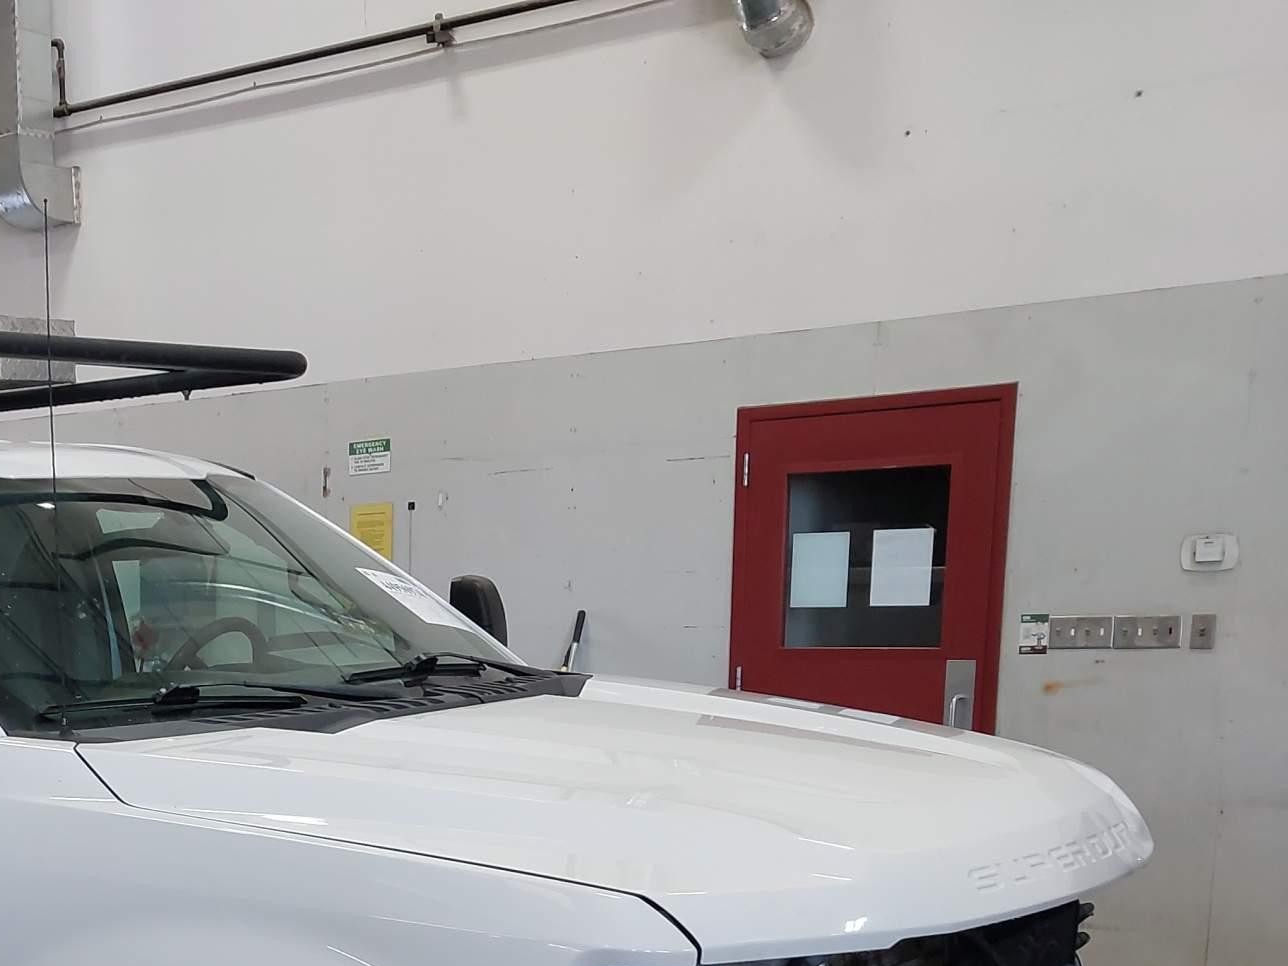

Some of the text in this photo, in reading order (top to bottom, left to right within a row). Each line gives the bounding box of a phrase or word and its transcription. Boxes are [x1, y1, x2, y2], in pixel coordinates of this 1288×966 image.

[353, 440, 387, 449] EMERGENCY
[356, 446, 384, 455] EYE WASH
